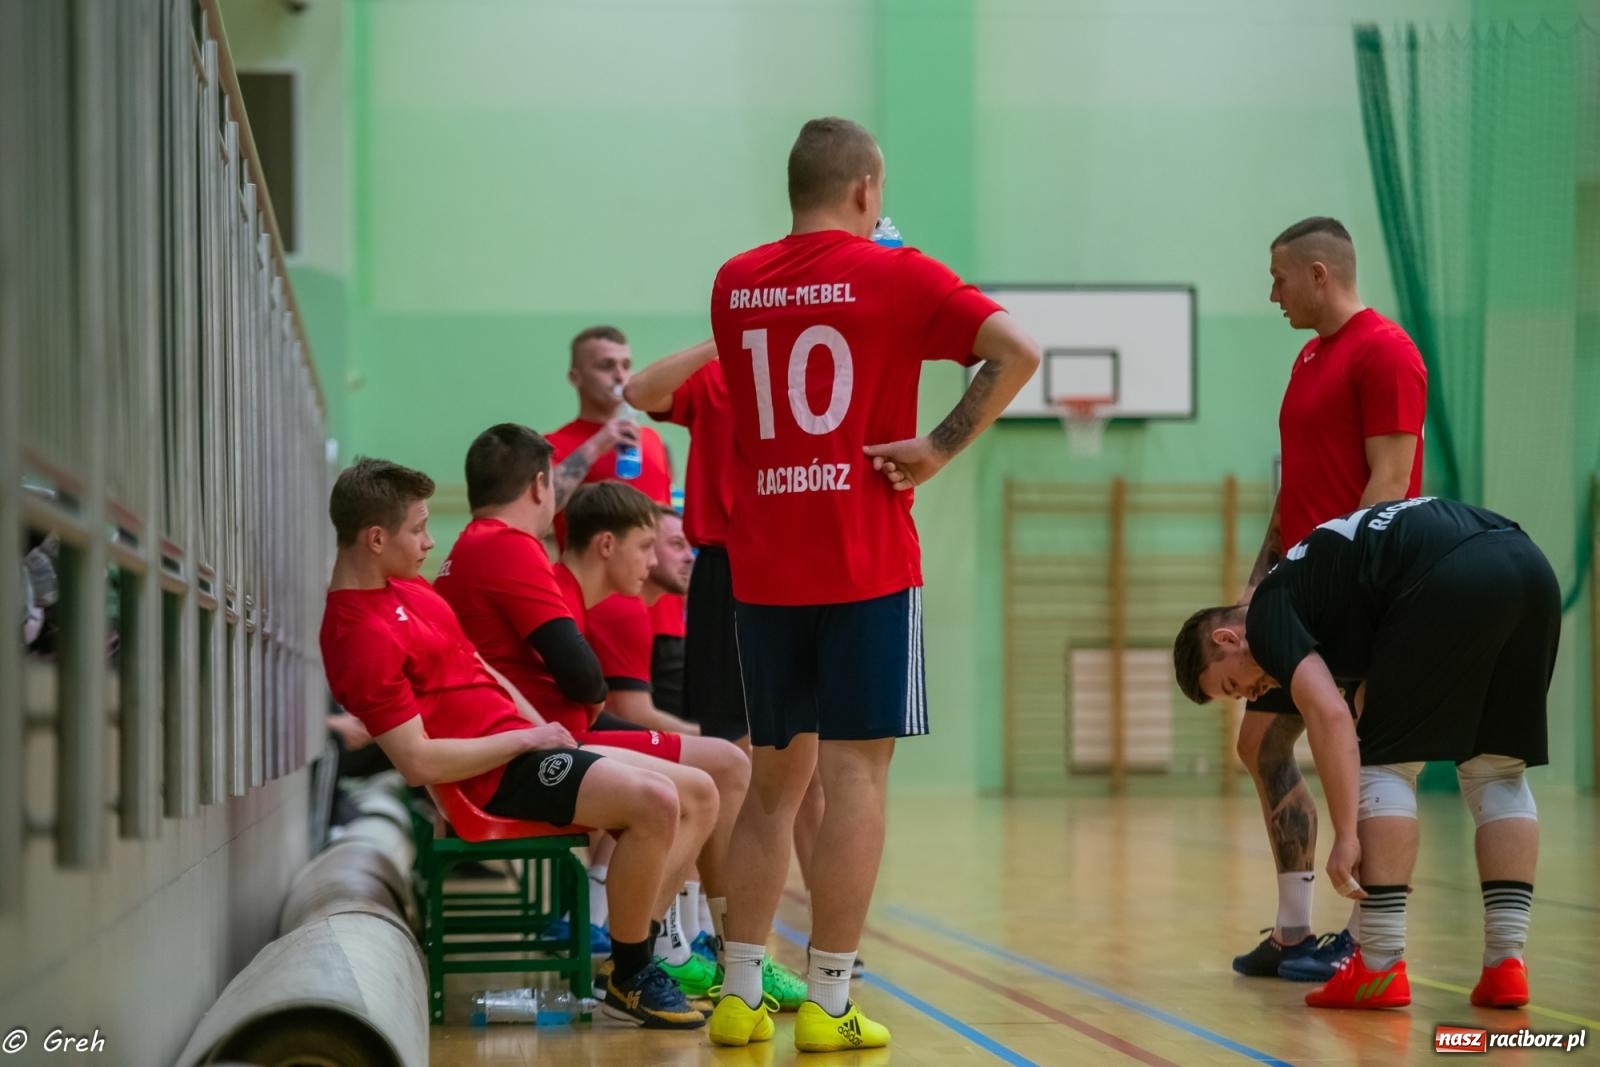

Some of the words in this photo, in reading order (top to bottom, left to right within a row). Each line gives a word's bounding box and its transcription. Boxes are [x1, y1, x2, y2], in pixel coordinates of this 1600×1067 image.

[729, 283, 856, 310] BRAUN-MEBEL
[742, 324, 854, 441] 10
[757, 457, 851, 496] RACIBÓRZ
